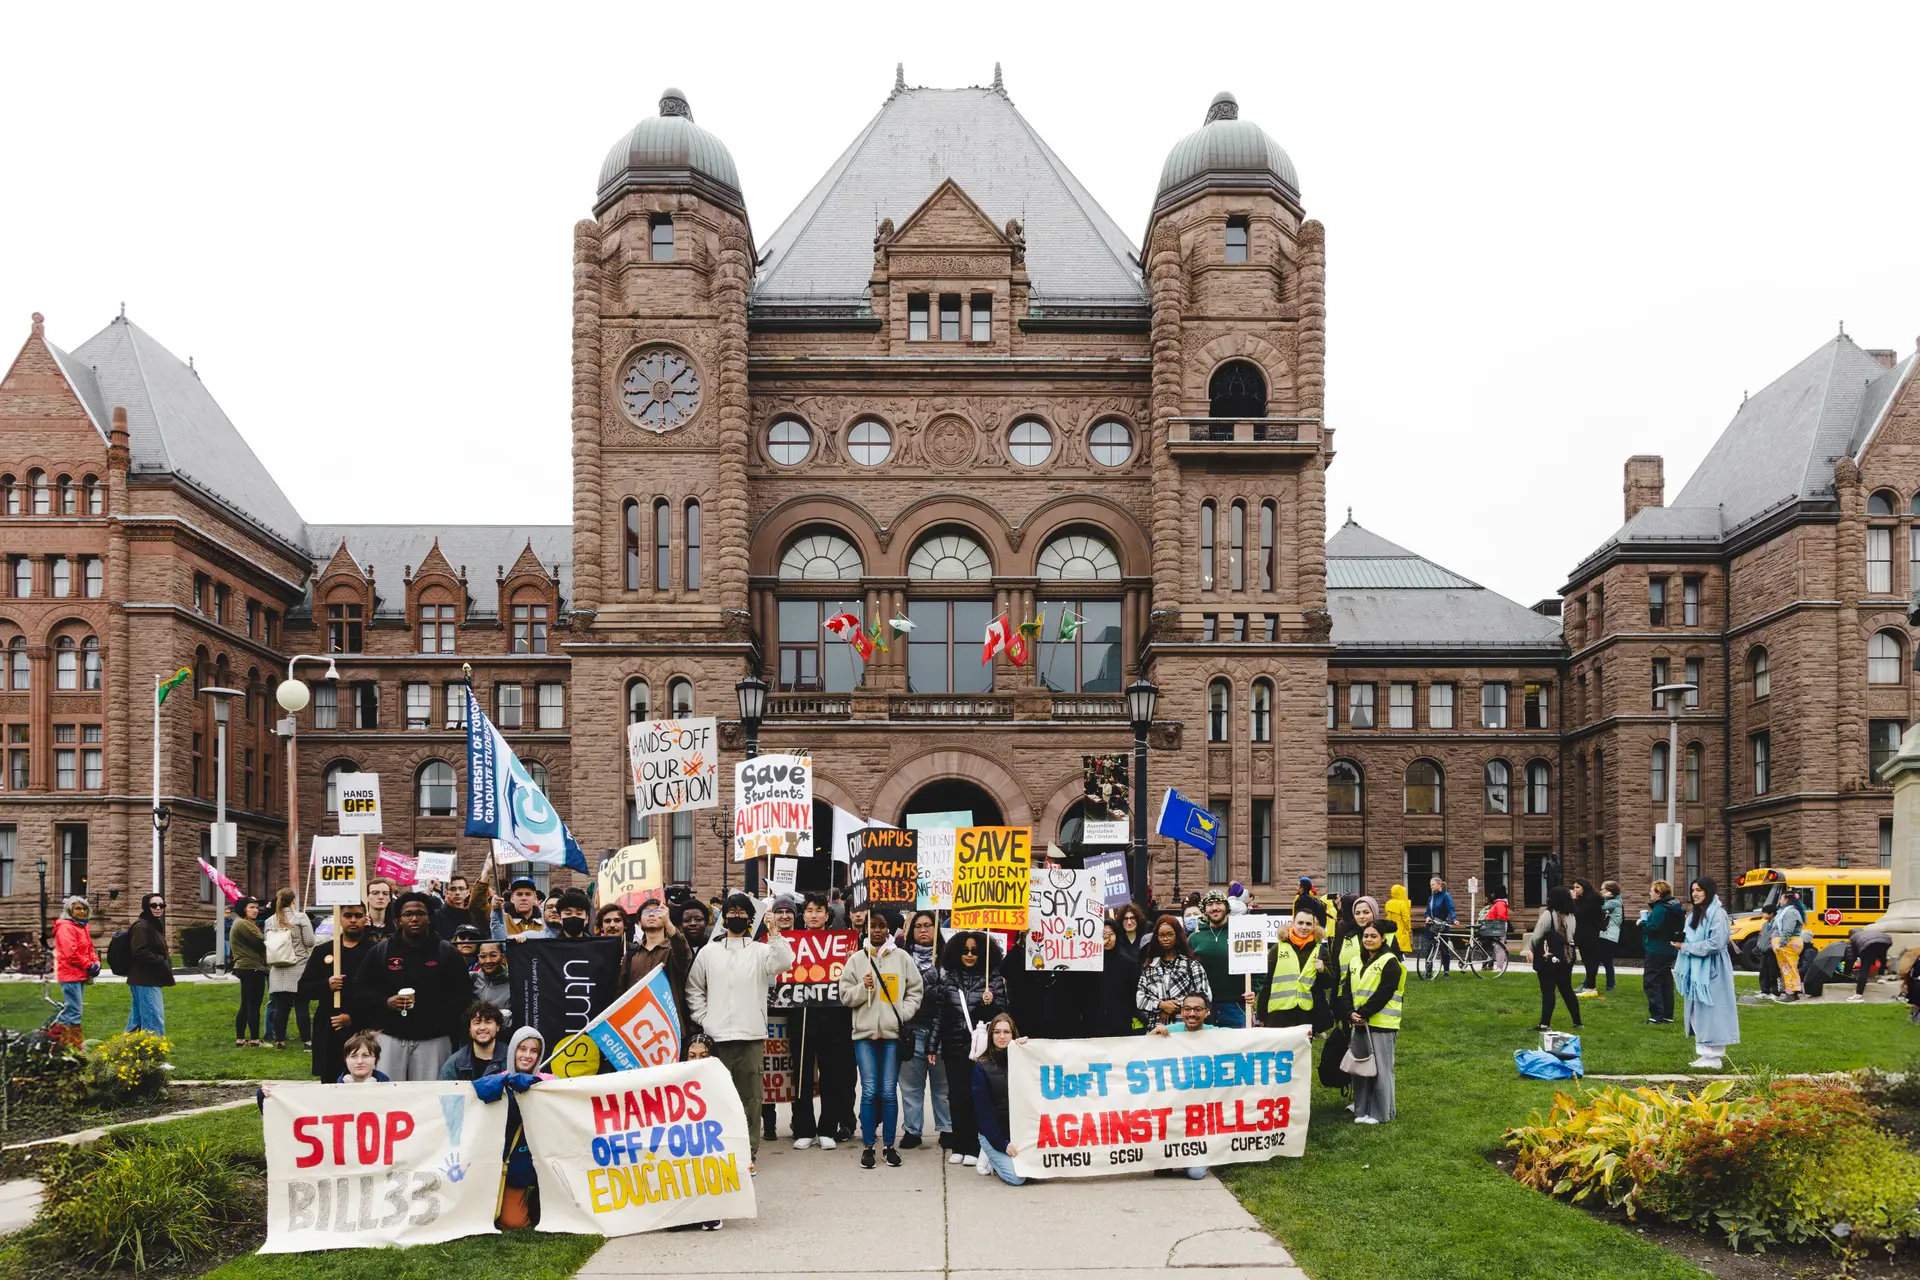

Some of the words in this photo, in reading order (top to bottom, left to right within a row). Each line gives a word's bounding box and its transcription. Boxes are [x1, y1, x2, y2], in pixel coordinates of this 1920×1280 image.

[472, 734, 482, 749] OF
[633, 731, 672, 753] HANDS
[678, 727, 710, 750] OFF
[642, 758, 679, 780] OUR
[741, 764, 806, 793] Save
[343, 790, 374, 798] HANDS
[472, 752, 483, 821] UNIVERSITY
[485, 767, 494, 824] GRADUATE
[636, 774, 712, 815] EDUCATION
[344, 799, 374, 812] OFF
[862, 829, 913, 849] CAMPUS
[958, 830, 1028, 864] SAVE
[322, 856, 354, 865] HANDS
[604, 849, 628, 878] VOTE
[864, 859, 919, 880] RIGHTS
[322, 865, 354, 881] OFF
[610, 858, 647, 894] NO
[958, 865, 1028, 881] STUDENT
[620, 883, 634, 893] TO
[954, 880, 1028, 904] AUTONOMY
[1041, 889, 1083, 918] SAY
[953, 911, 981, 927] STOP
[1040, 916, 1066, 935] NO
[1075, 917, 1096, 939] TO
[1826, 913, 1841, 921] STOP
[1234, 930, 1262, 940] HANDS
[1234, 939, 1262, 953] OFF
[787, 934, 848, 964] SAVE
[777, 982, 838, 1003] CENTE
[632, 1019, 670, 1066] cfs
[1125, 1050, 1294, 1095] STUDENTS
[764, 1087, 795, 1103] ILL
[590, 1080, 708, 1135] HANDS
[293, 1110, 415, 1169] STOP
[1036, 1106, 1173, 1149] AGAINST
[1043, 1151, 1091, 1168] UTMSU
[1109, 1148, 1144, 1165] SCSU
[1163, 1141, 1208, 1158] UTGSU
[588, 1152, 742, 1215] EDUCATION
